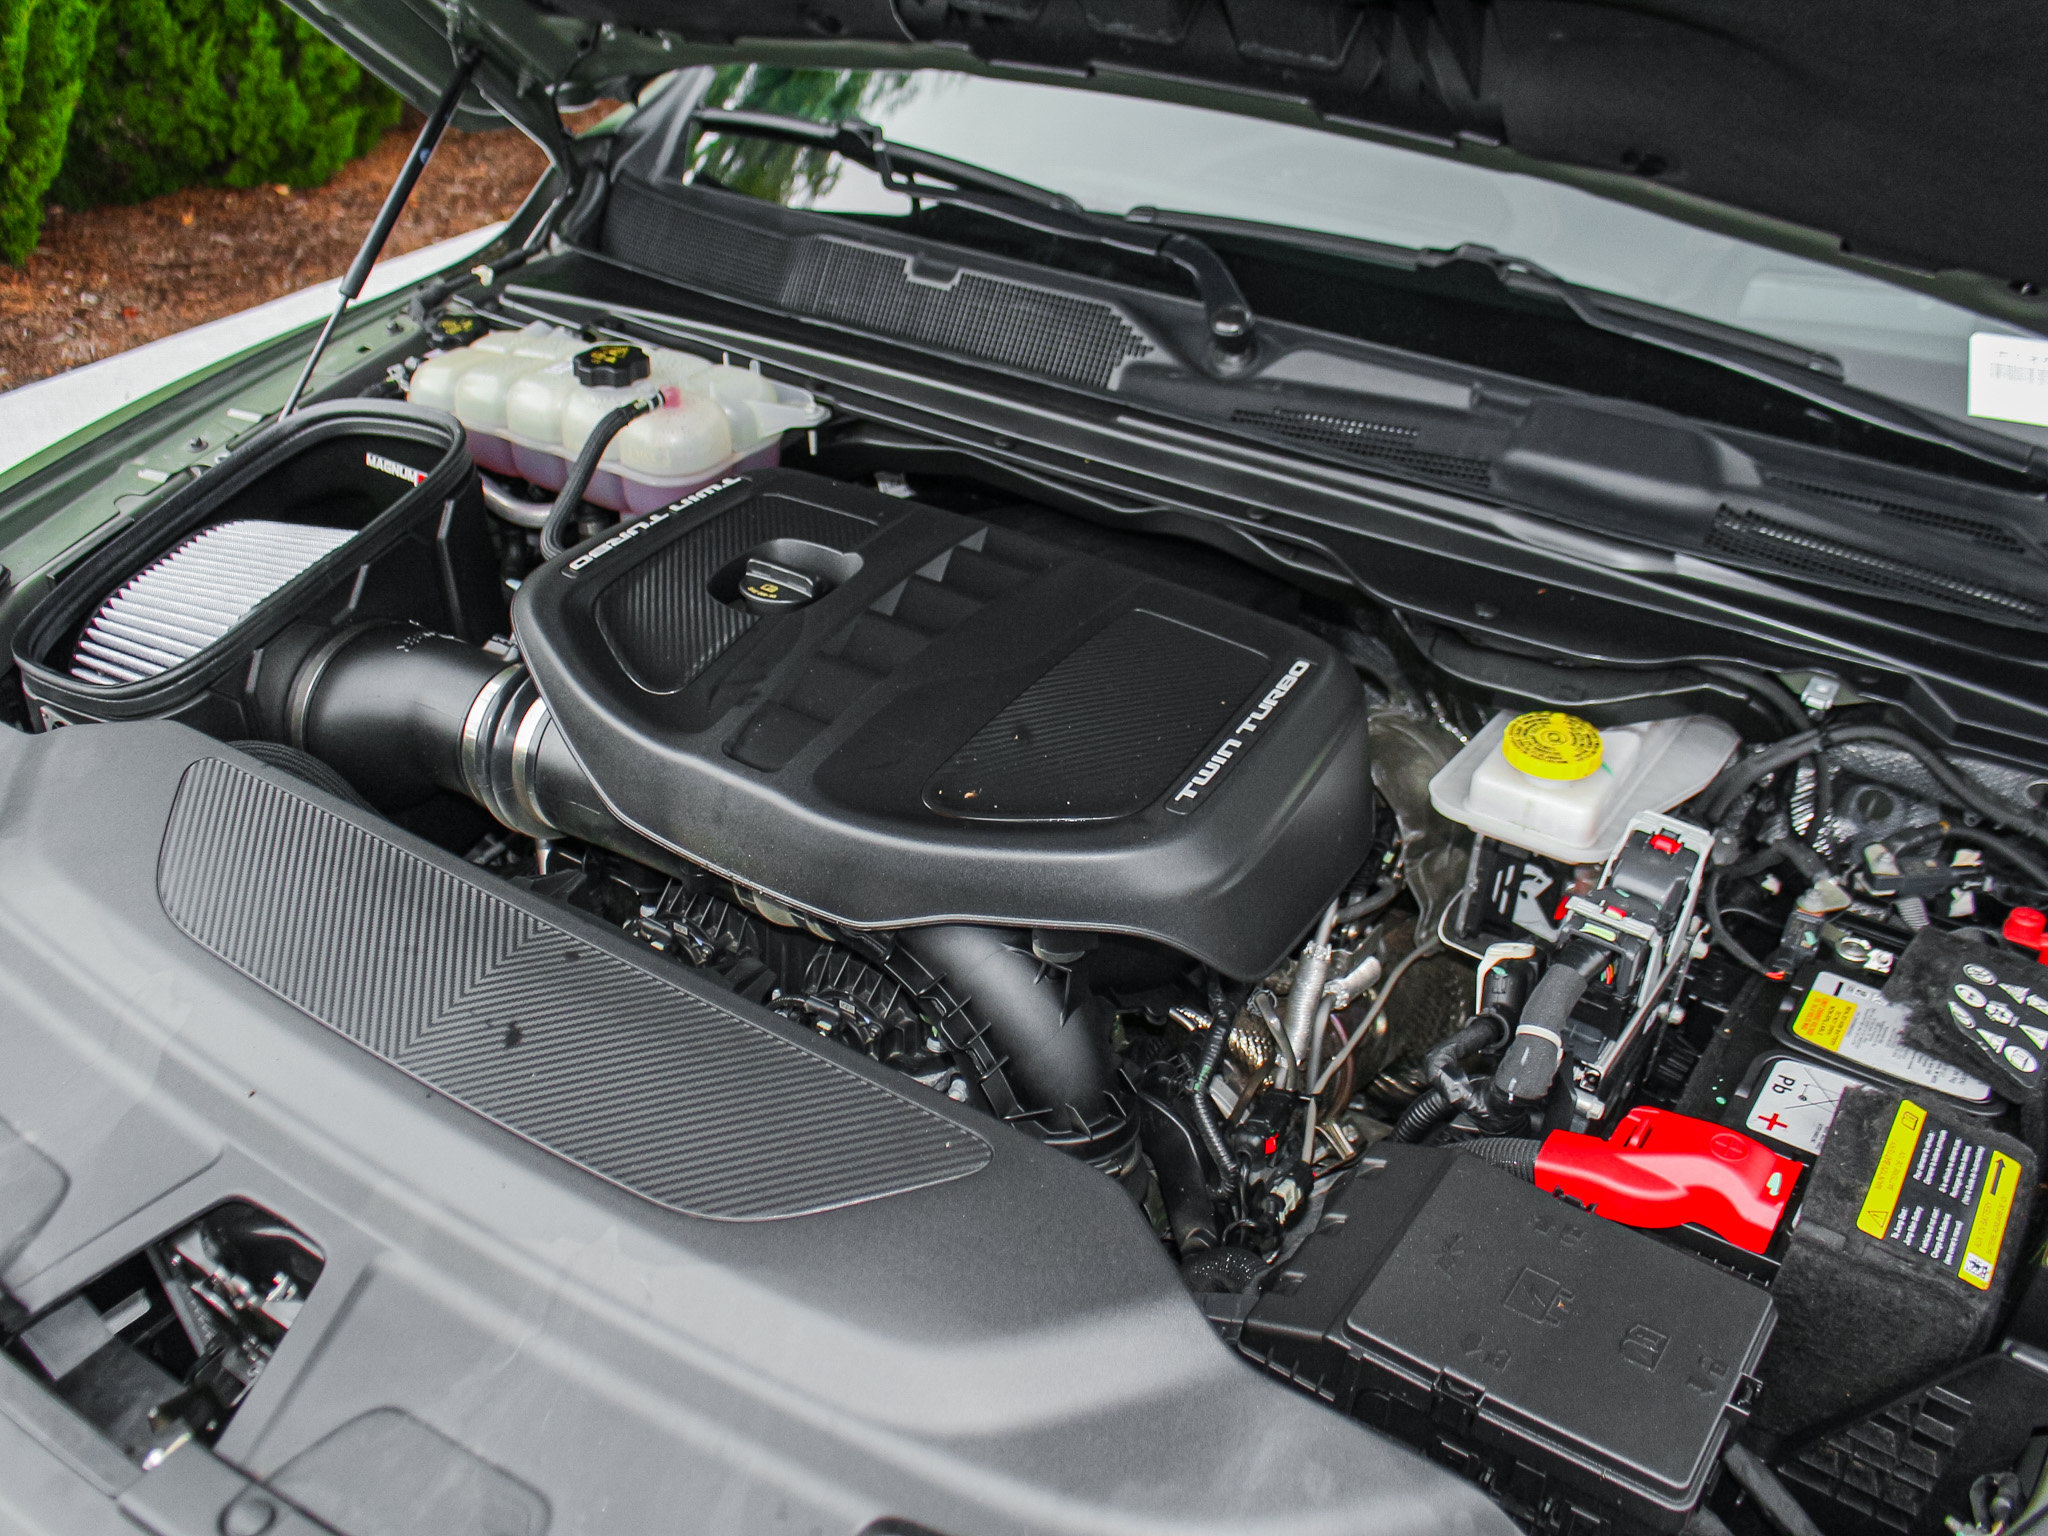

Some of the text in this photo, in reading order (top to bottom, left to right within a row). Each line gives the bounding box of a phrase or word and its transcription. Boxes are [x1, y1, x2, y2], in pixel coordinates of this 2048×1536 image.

[366, 453, 422, 487] MAGNUM
[570, 477, 741, 570] TWIN TURBO
[1174, 659, 1310, 801] TWIN TURBO
